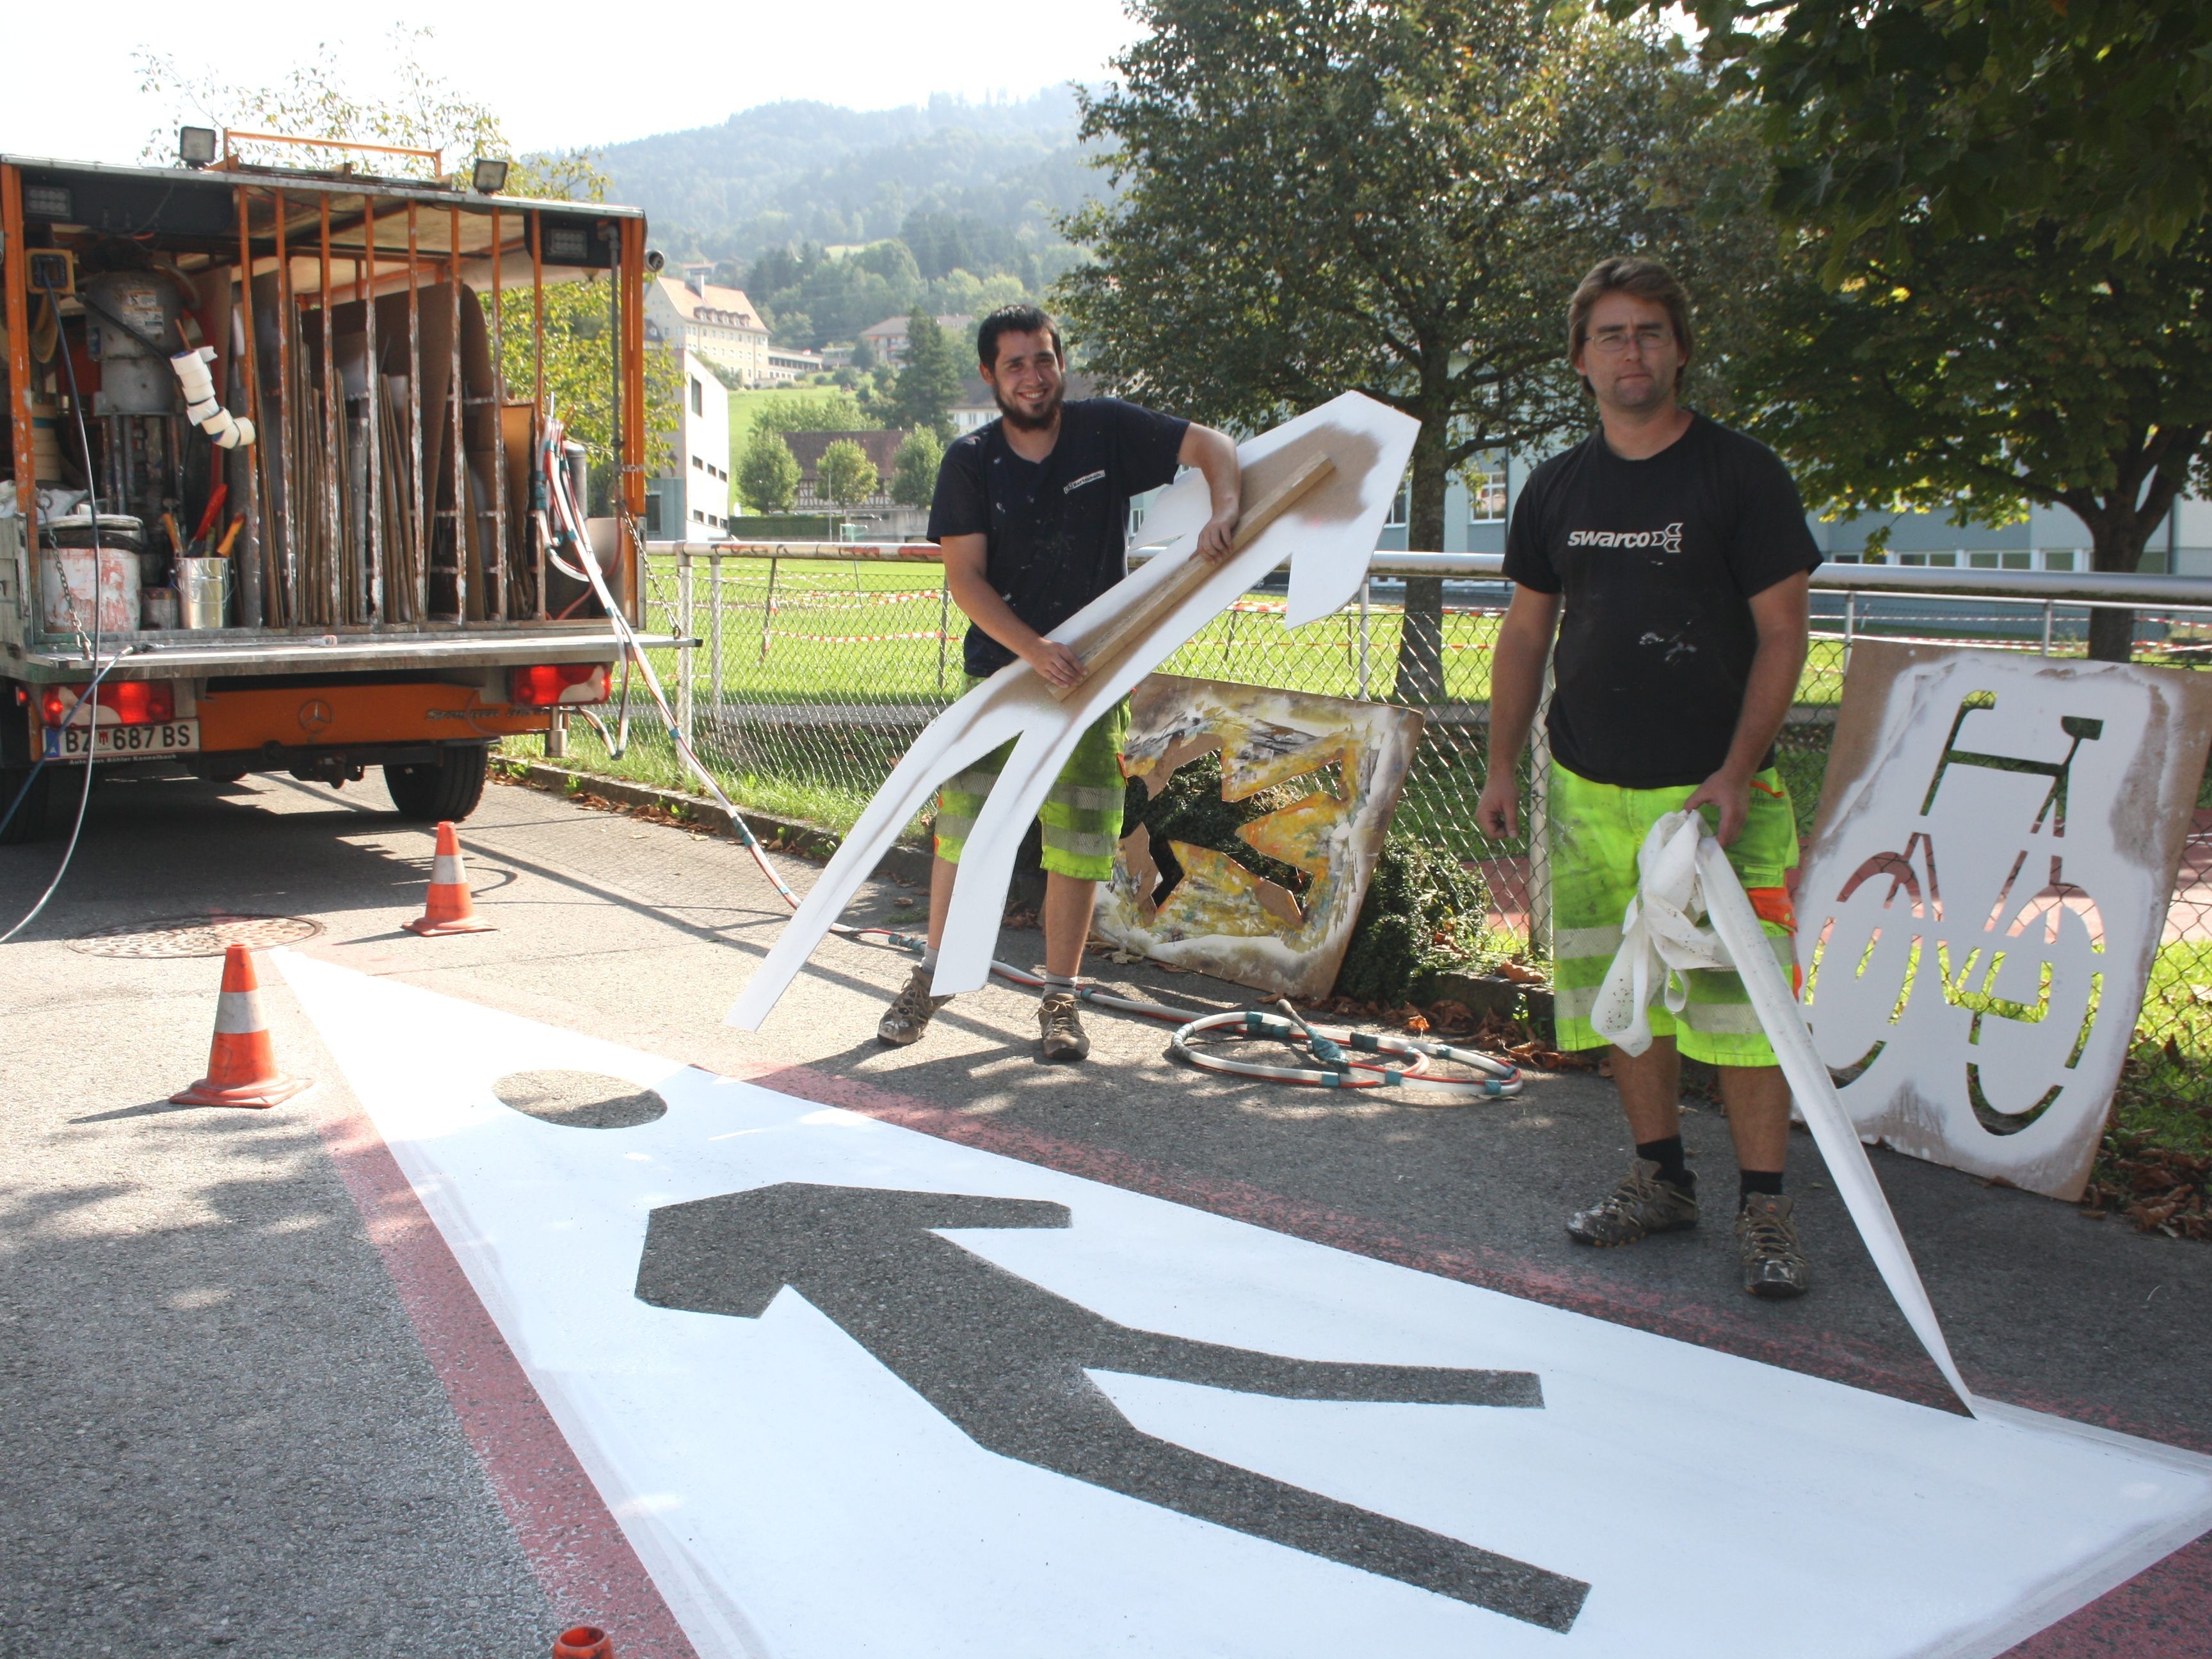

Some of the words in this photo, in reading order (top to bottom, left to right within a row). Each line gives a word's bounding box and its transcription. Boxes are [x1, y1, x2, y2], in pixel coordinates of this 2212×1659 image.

[1567, 531, 1651, 549] swarco
[113, 726, 155, 750] 687
[163, 725, 190, 748] BS
